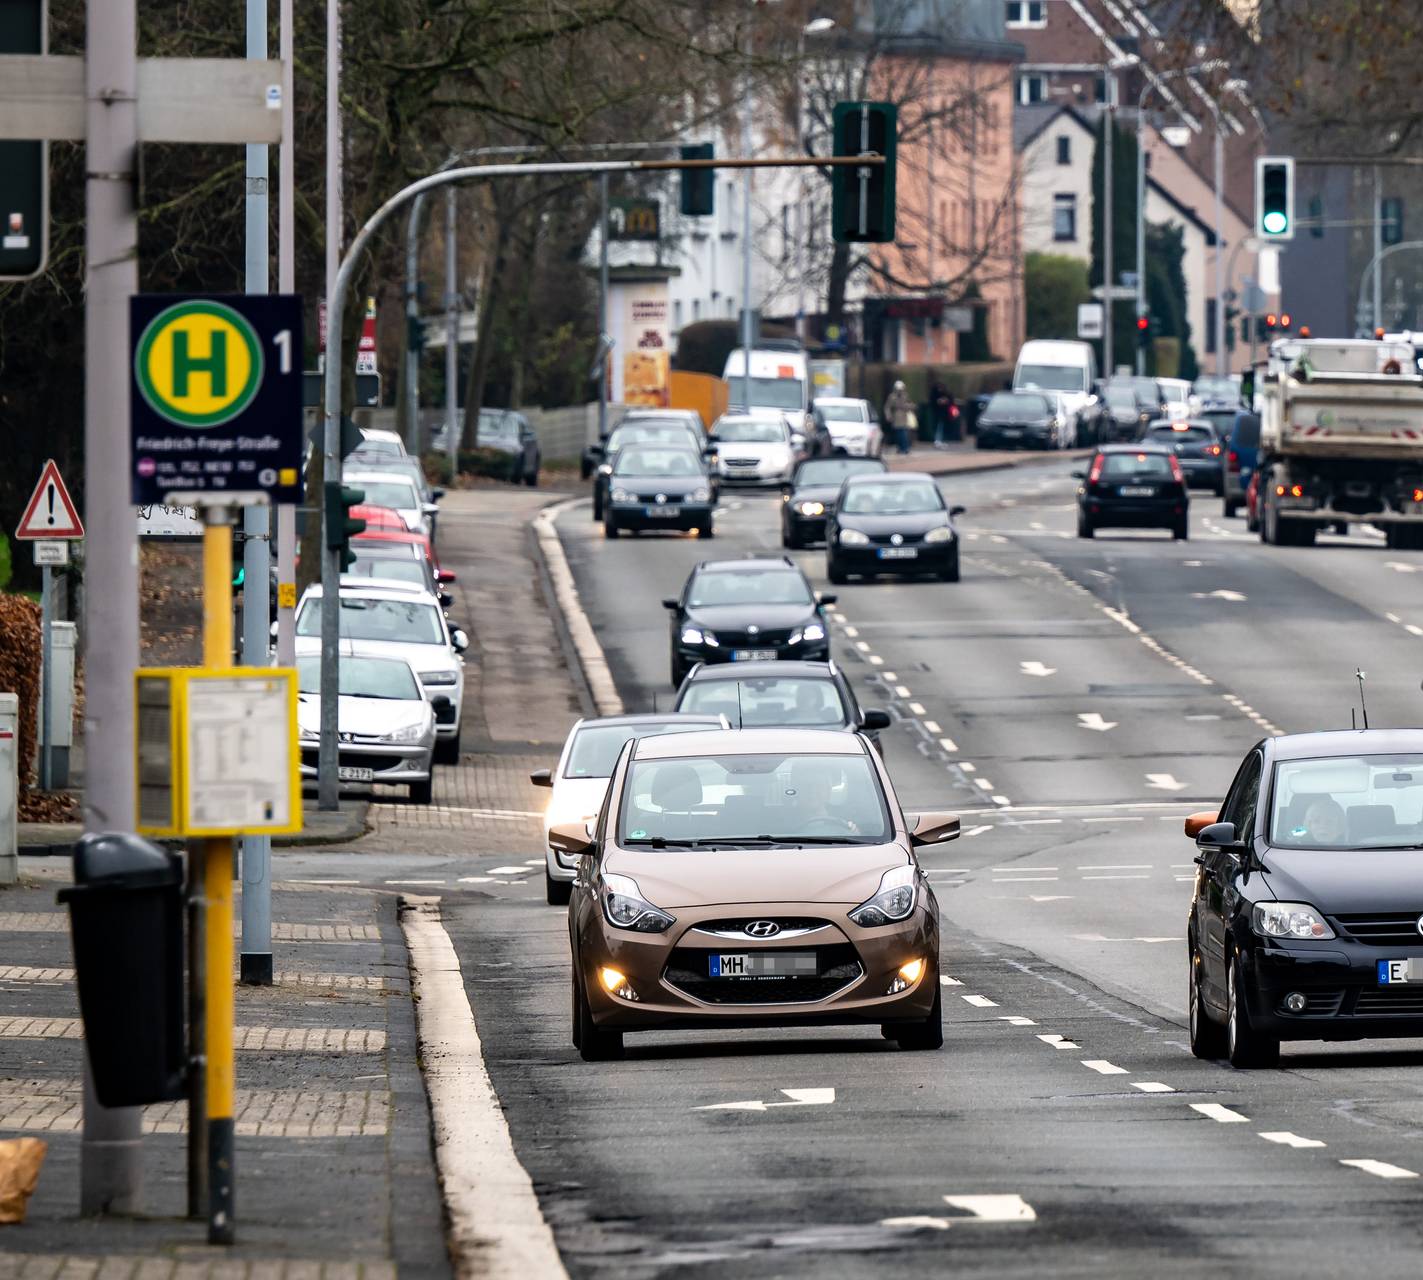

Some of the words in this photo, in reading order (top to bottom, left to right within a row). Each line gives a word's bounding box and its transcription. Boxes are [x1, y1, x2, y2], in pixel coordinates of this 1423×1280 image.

[172, 330, 227, 397] H
[273, 329, 291, 374] 1
[720, 957, 744, 974] MH
[1390, 963, 1402, 981] E
